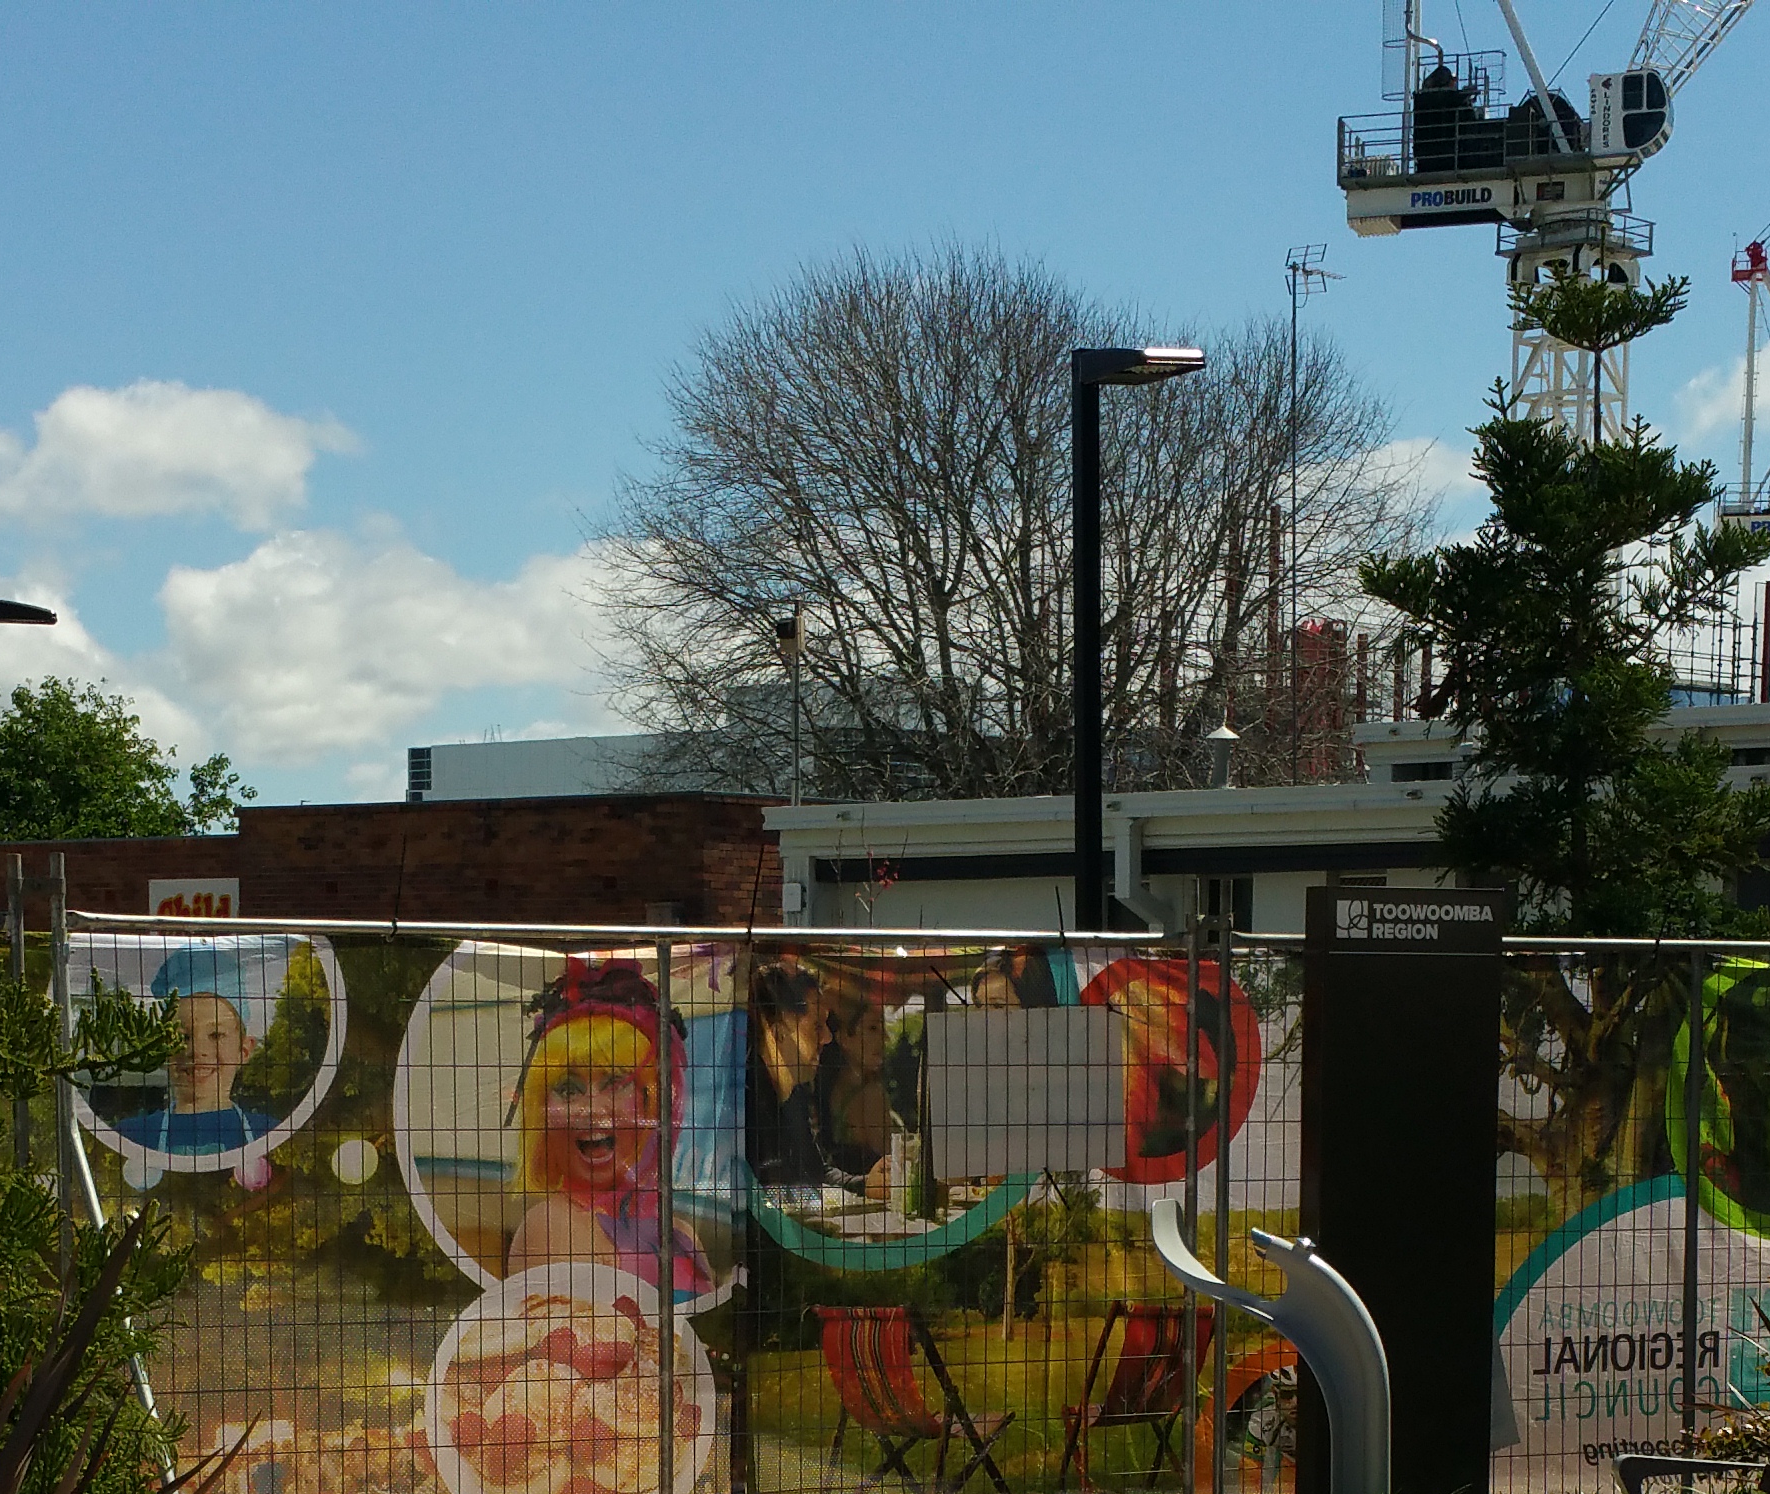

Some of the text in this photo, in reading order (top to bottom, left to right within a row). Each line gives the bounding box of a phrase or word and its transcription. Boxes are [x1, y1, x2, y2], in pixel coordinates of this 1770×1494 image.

[1602, 91, 1612, 149] LINDORES
[1410, 187, 1493, 207] PROBUILD
[1372, 903, 1494, 922] TOOWOOMBA
[1371, 922, 1440, 940] REGION
